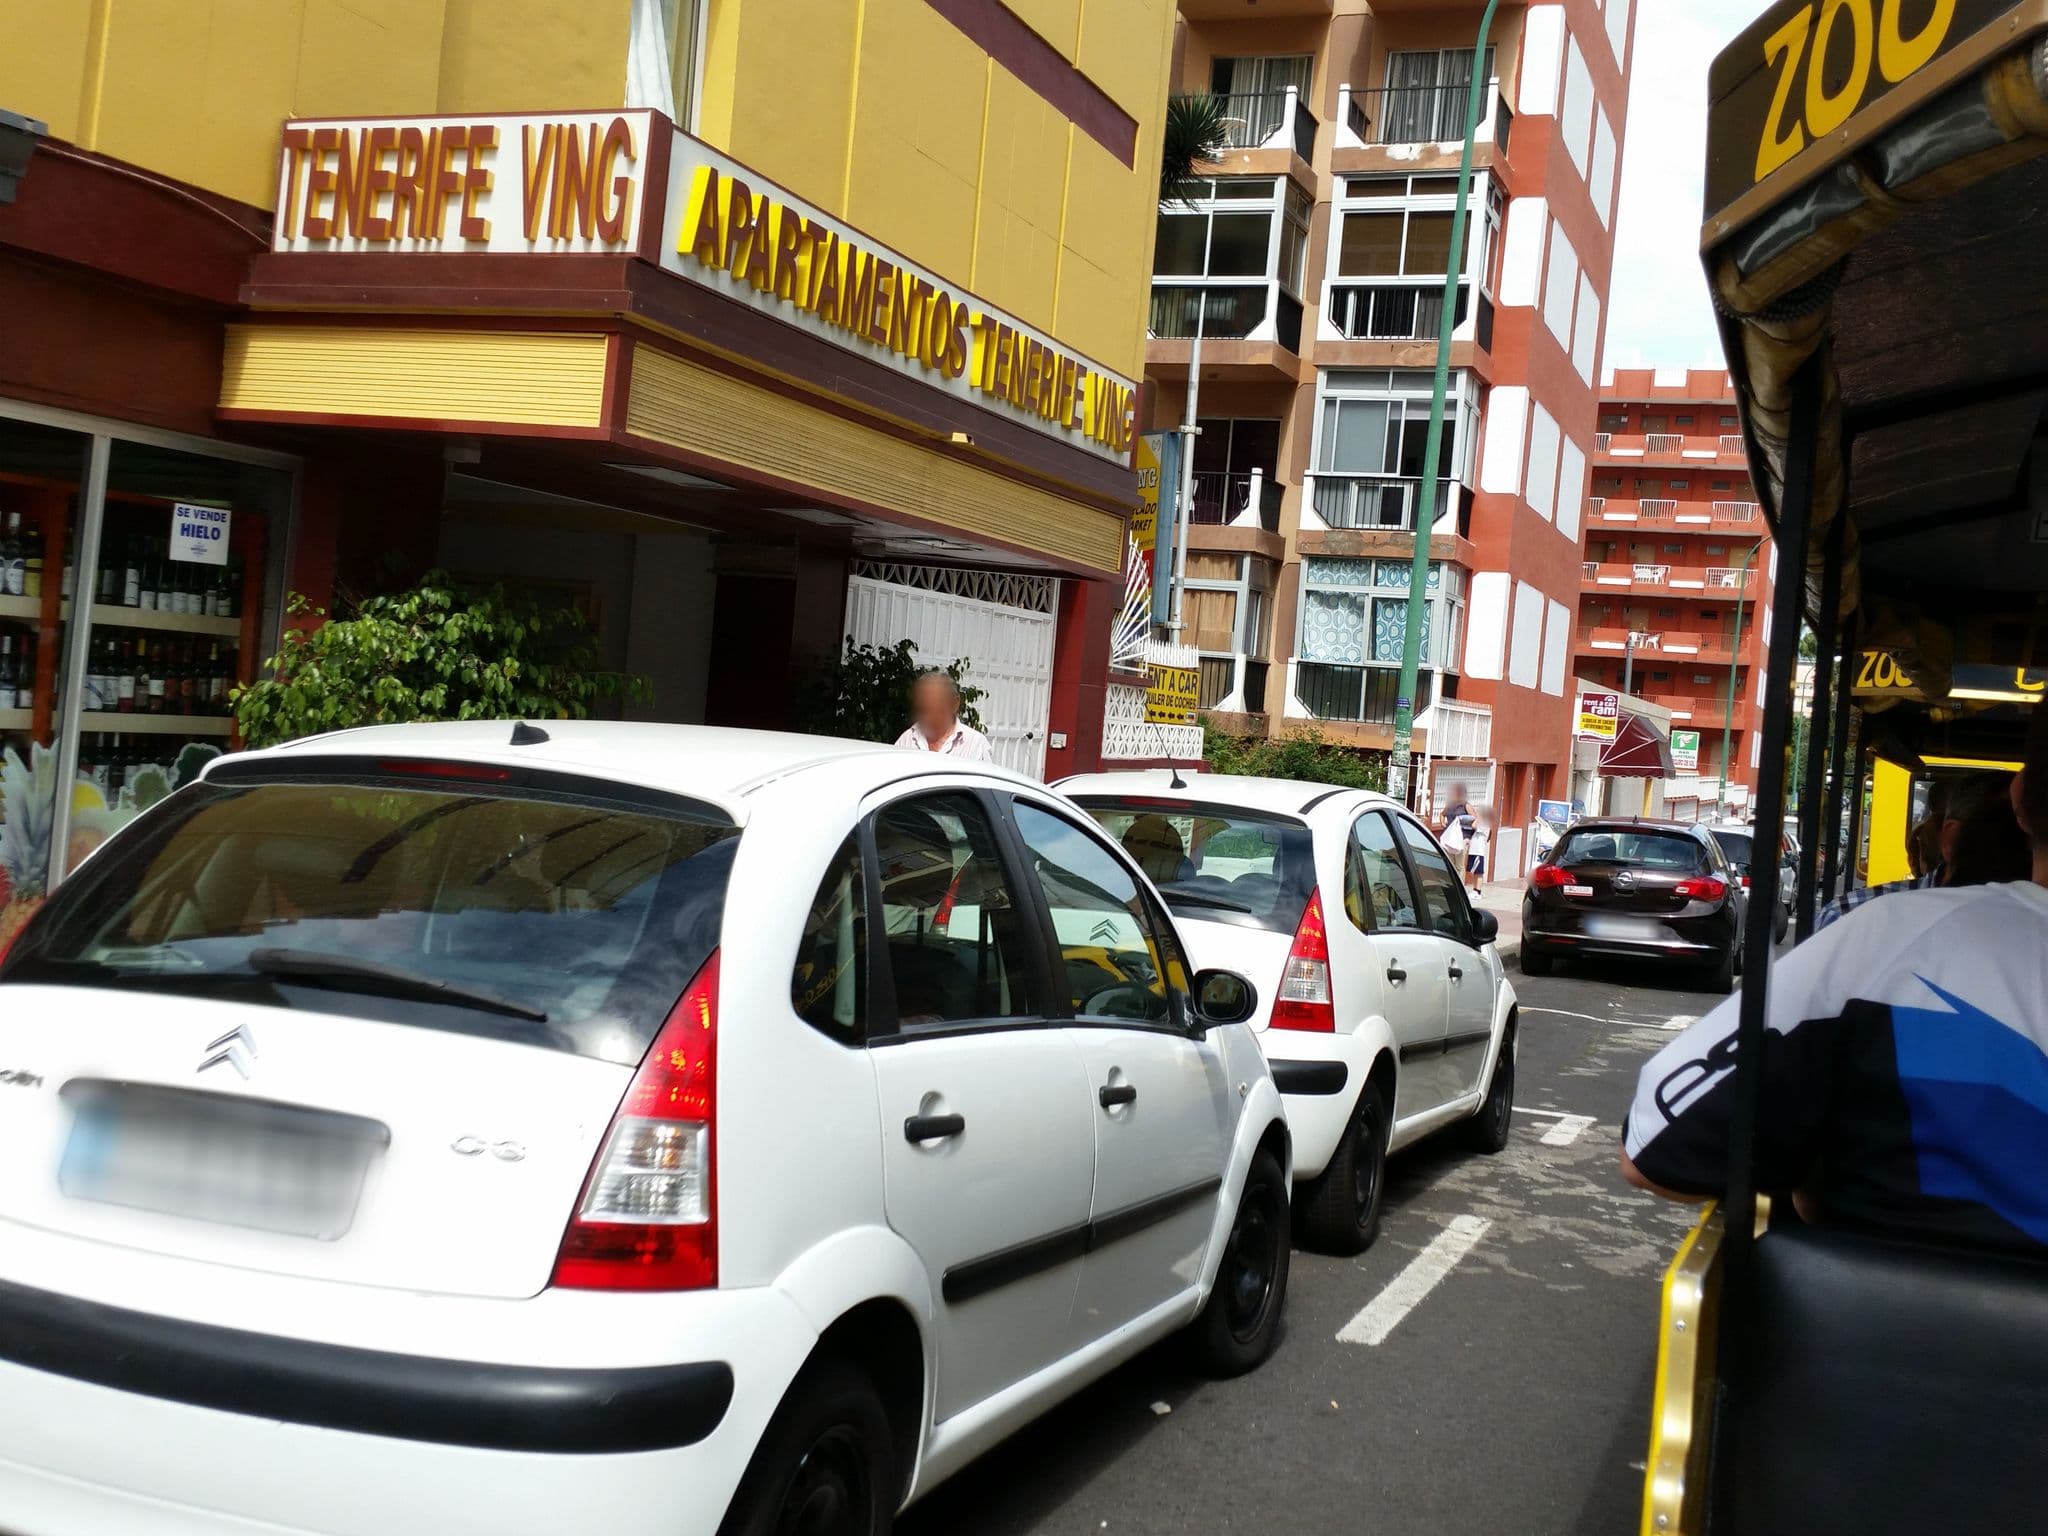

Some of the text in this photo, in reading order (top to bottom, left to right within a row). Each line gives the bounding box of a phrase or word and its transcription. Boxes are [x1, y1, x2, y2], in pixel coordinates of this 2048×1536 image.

[282, 117, 637, 242] TENERIFE VING
[677, 166, 1135, 451] APARTAMENTOS TENERIFE VING
[177, 507, 227, 523] SE VENDE
[180, 523, 221, 540] HIELO
[1168, 671, 1175, 692] A
[1178, 672, 1198, 695] CAR
[1591, 705, 1616, 716] ram
